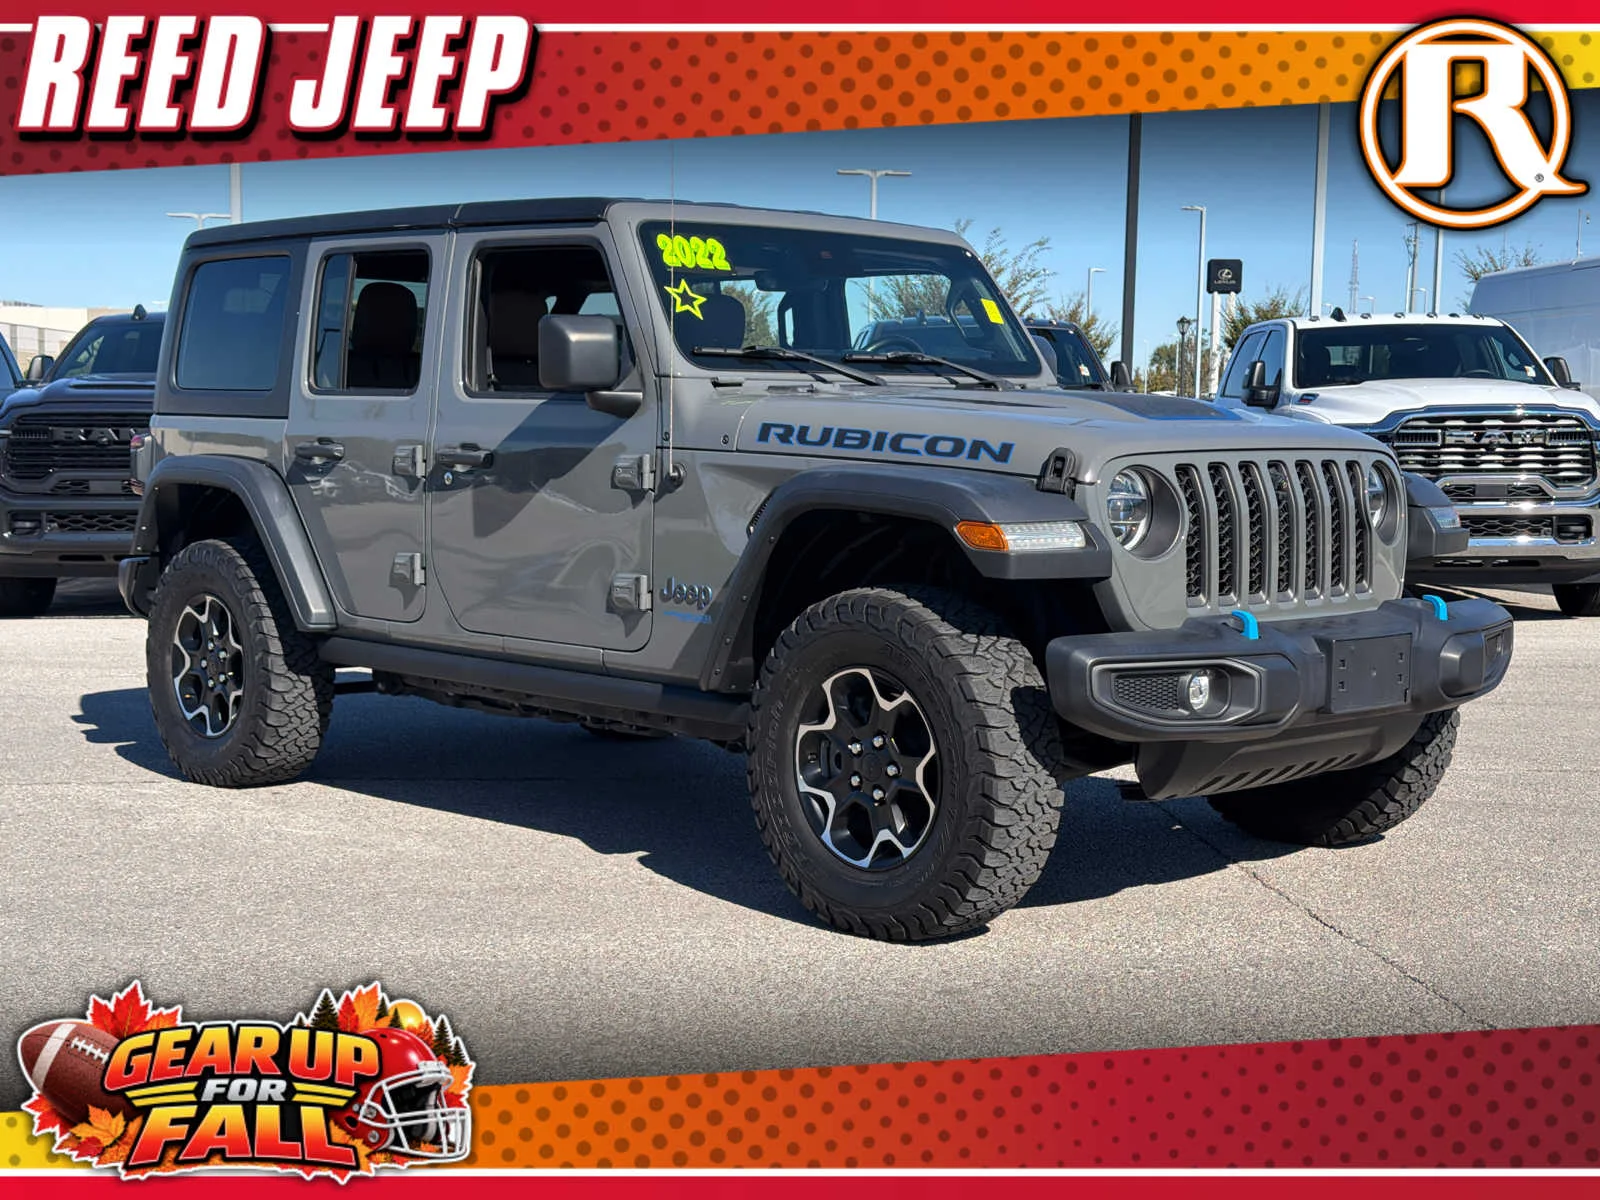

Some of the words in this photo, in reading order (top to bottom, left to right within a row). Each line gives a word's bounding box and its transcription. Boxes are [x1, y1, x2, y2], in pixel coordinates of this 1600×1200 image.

[656, 234, 732, 271] 2022
[757, 422, 1015, 464] RUBICON
[659, 576, 713, 611] Jeep
